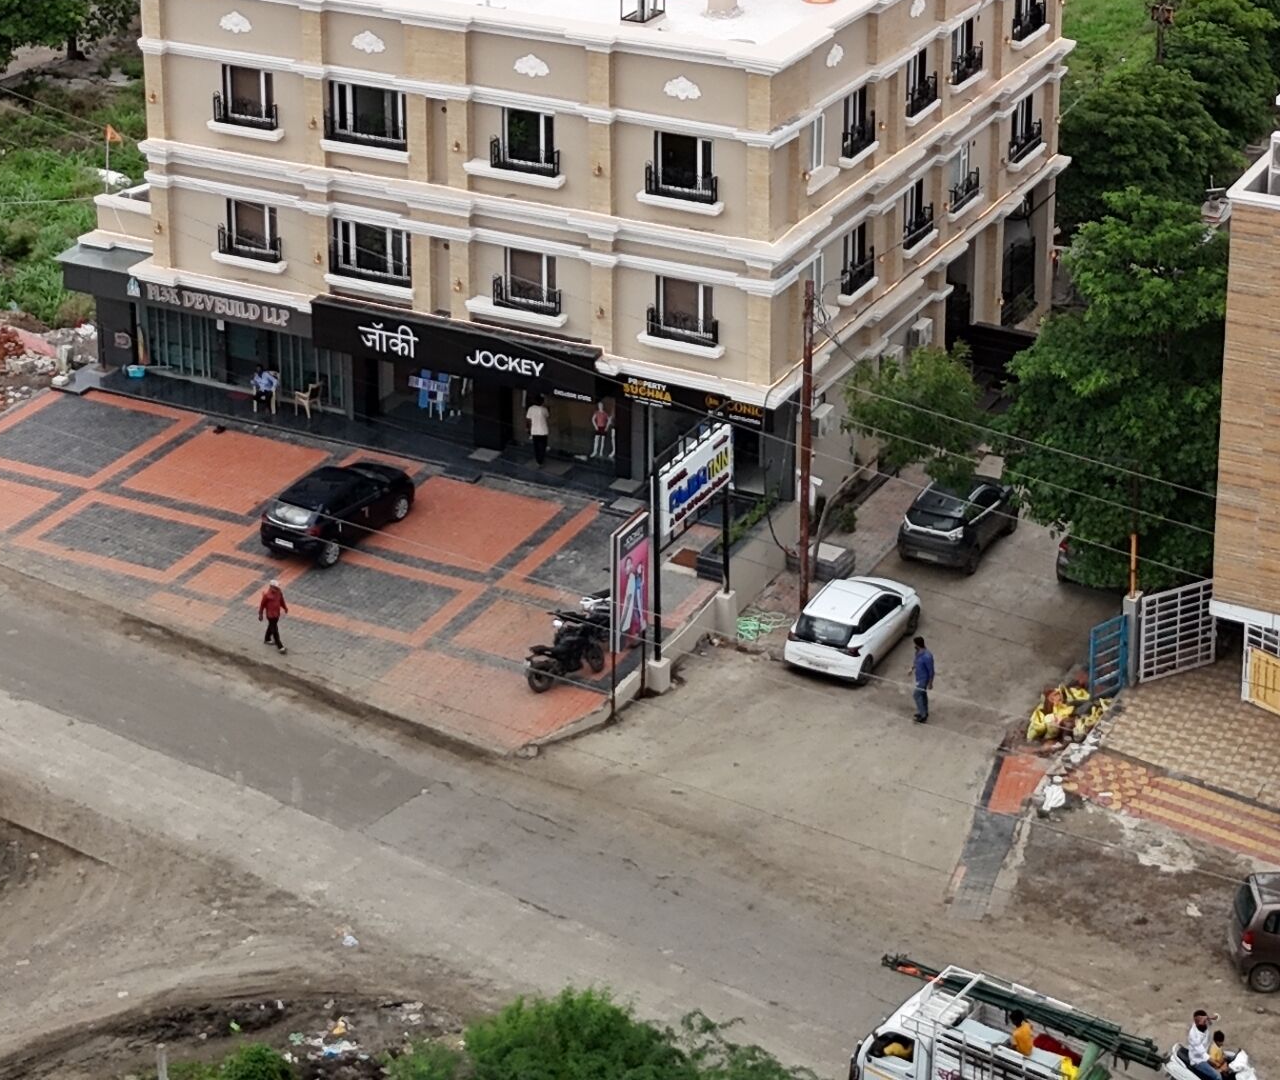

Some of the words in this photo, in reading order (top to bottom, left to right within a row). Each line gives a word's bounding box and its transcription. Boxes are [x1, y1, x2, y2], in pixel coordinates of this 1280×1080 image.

[181, 290, 261, 320] DEVBUILD
[261, 306, 290, 327] LLP
[358, 322, 419, 358] जॉकी
[466, 349, 545, 378] JOCKEY
[622, 383, 672, 402] SUCHNA
[627, 377, 667, 391] PROPERTY
